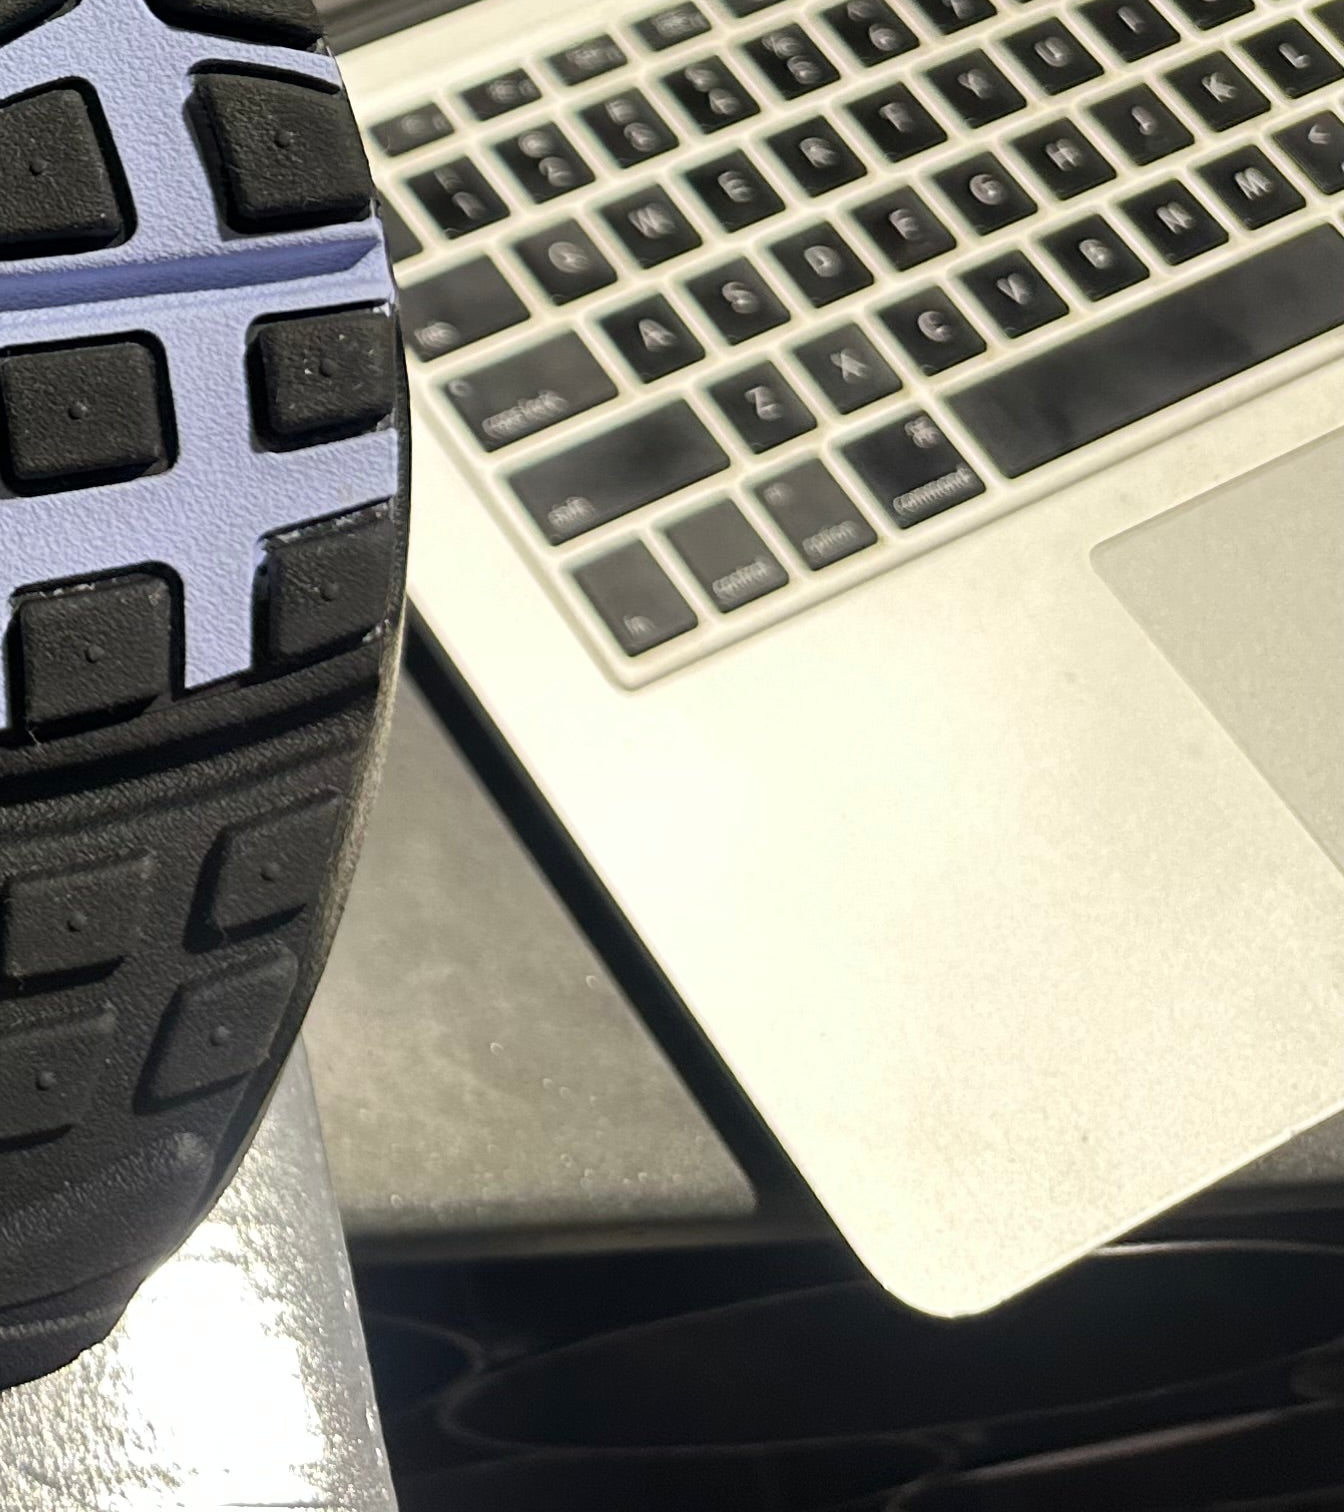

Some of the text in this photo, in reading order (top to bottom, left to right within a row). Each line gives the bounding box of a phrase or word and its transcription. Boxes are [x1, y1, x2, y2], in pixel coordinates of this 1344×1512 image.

[1034, 36, 1071, 68] U
[1278, 42, 1310, 69] L
[1201, 71, 1237, 103] K
[1045, 137, 1082, 172] H
[969, 173, 1005, 205] G
[1234, 166, 1274, 201] M
[803, 244, 843, 278] D
[996, 272, 1031, 305] V
[638, 318, 674, 352] A
[830, 347, 869, 384] X
